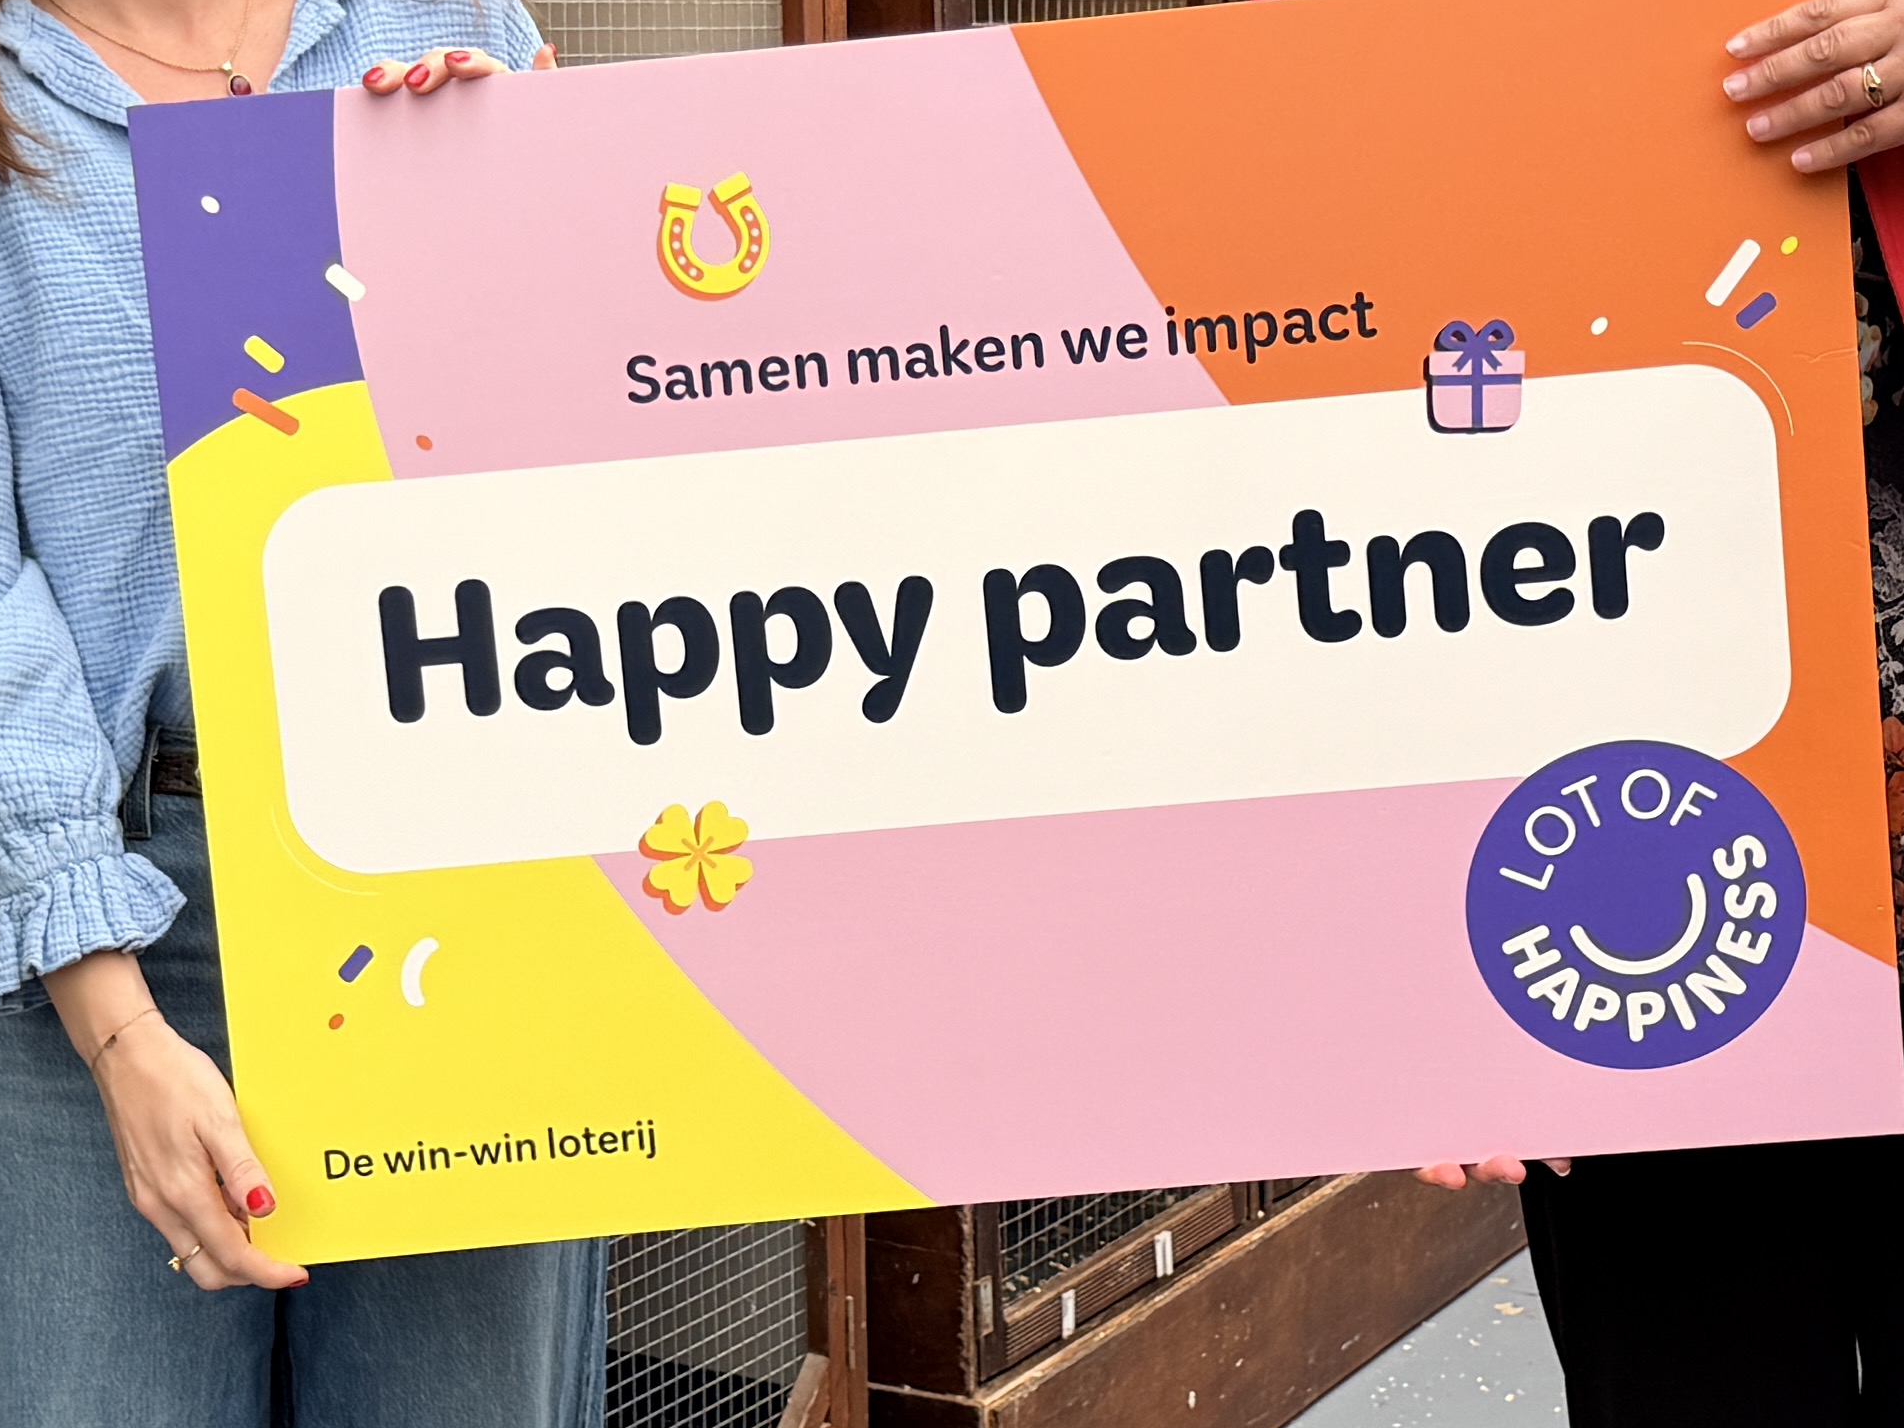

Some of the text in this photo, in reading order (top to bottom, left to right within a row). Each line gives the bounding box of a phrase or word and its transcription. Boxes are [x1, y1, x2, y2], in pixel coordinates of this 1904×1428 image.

[625, 290, 1380, 405] Samen maken we impact
[377, 508, 1667, 747] Happy partner
[1498, 767, 1719, 892] LOT OF
[1500, 833, 1779, 1044] HAPPINESS
[323, 1119, 657, 1181] De win-win loterij
